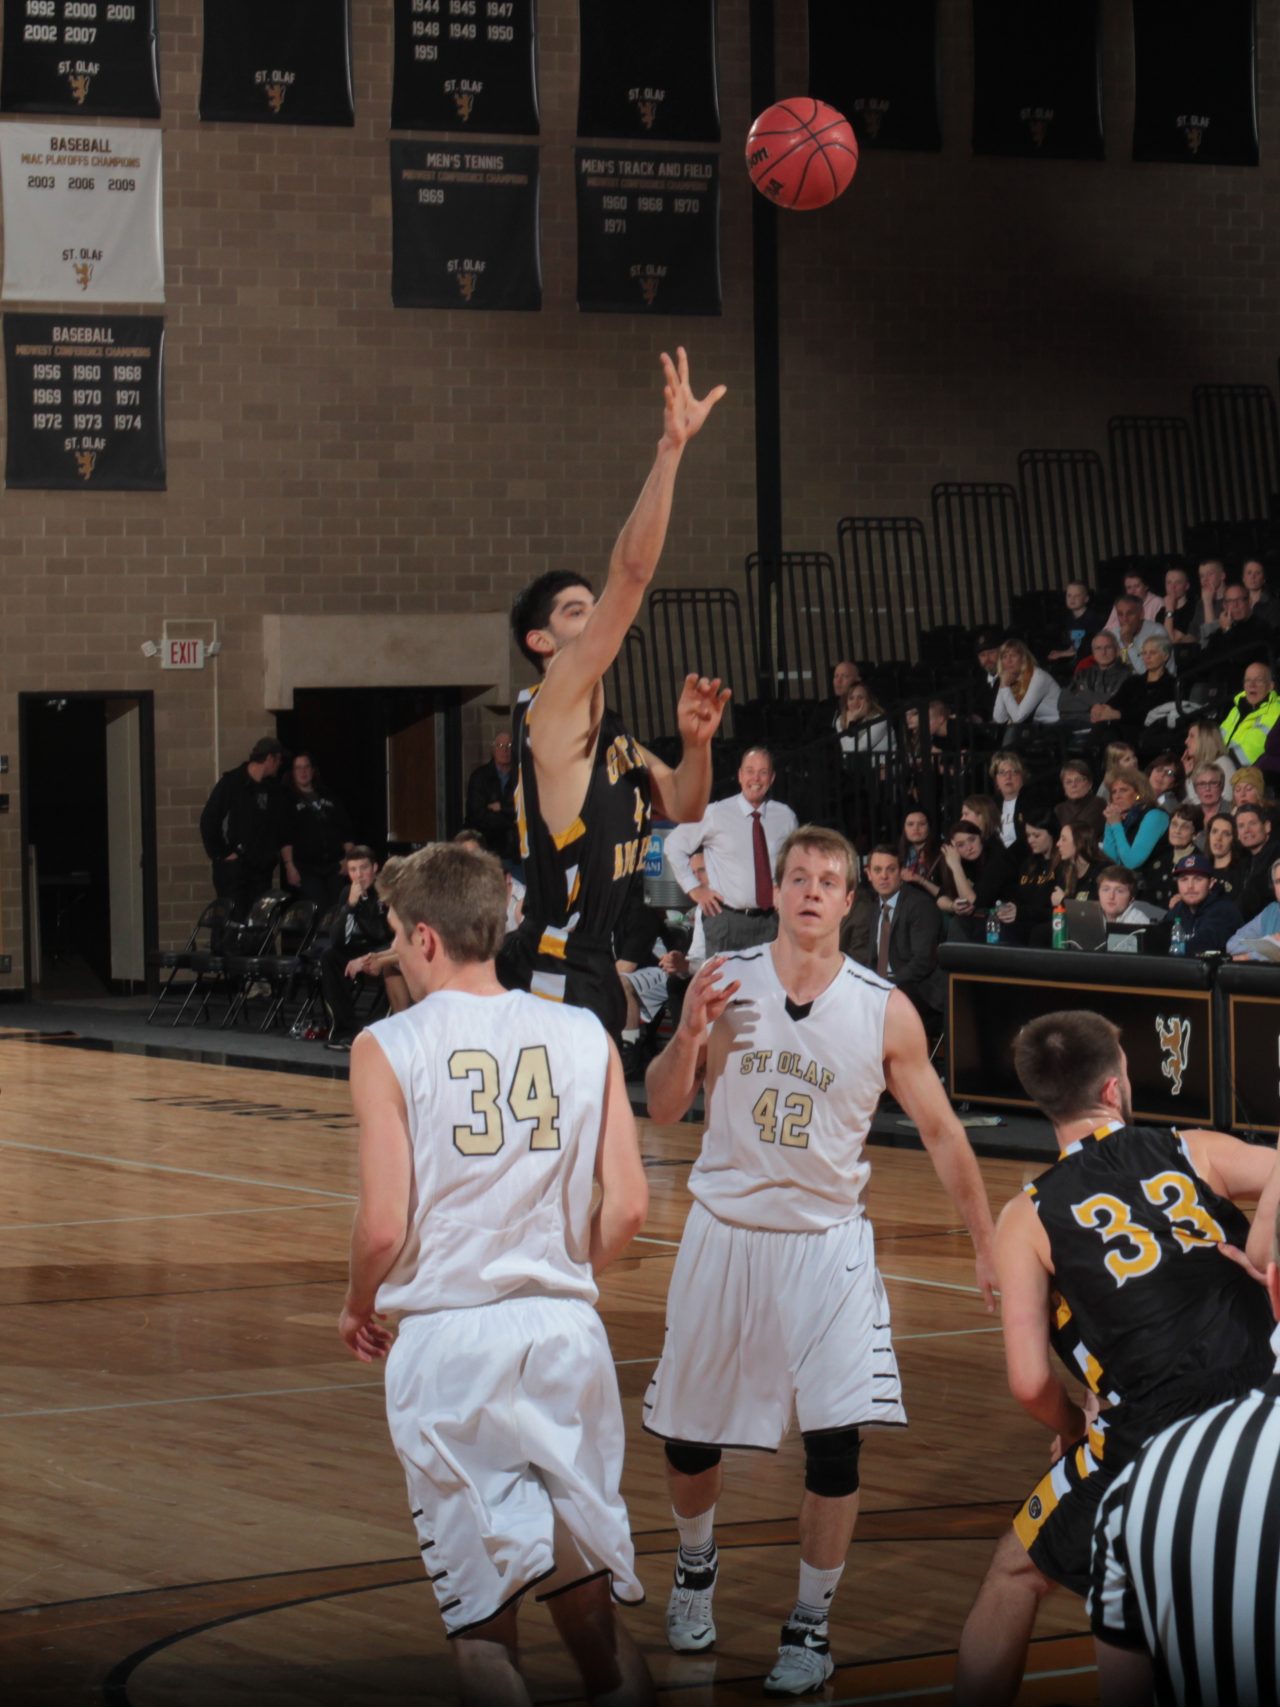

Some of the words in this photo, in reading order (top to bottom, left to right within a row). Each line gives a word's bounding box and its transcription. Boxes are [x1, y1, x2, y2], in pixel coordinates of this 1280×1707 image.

[26, 0, 55, 16] 1992
[64, 2, 97, 18] 2000
[107, 4, 136, 20] 2001
[412, 0, 440, 13] 1944
[449, 0, 477, 15] 1945
[486, 2, 514, 17] 1947
[24, 24, 57, 41] 2002
[64, 27, 97, 43] 2007
[412, 21, 440, 37] 1948
[449, 23, 477, 39] 1949
[487, 25, 514, 41] 1950
[414, 44, 438, 60] 1951
[58, 61, 73, 75] ST.
[75, 60, 100, 75] OLAF
[255, 70, 270, 83] ST.
[272, 70, 296, 84] OLAF
[444, 80, 459, 94] ST.
[460, 80, 484, 94] OLAF
[644, 88, 666, 101] OLAF
[50, 137, 112, 153] BASEBALL
[21, 153, 43, 166] MIAC
[46, 154, 89, 167] PLAYOFFS
[426, 153, 461, 169] MEN'S
[464, 154, 504, 170] TENNIS
[581, 158, 615, 174] MEN'S
[618, 160, 655, 176] TRACK
[658, 162, 681, 178] AND
[683, 163, 712, 178] FIELD
[28, 175, 55, 188] 2003
[68, 177, 95, 190] 2006
[108, 178, 136, 191] 2009
[418, 188, 445, 204] 1969
[673, 198, 700, 213] 1970
[604, 218, 626, 233] 1971
[62, 249, 77, 261] ST.
[80, 248, 103, 261] OLAF
[447, 259, 462, 272] ST.
[463, 259, 486, 272] OLAF
[52, 326, 114, 343] BASEBALL
[33, 364, 61, 380] 1956
[73, 364, 101, 381] 1960
[113, 365, 142, 381] 1968
[33, 389, 61, 405] 1969
[73, 389, 102, 406] 1970
[116, 390, 140, 406] 1971
[33, 413, 62, 429] 1972
[73, 414, 102, 430] 1973
[114, 414, 142, 430] 1974
[64, 437, 80, 450] ST.
[82, 436, 106, 450] OLAF
[171, 641, 198, 664] EXIT
[740, 1050, 773, 1075] ST.
[777, 1051, 835, 1093] OLAF
[448, 1045, 561, 1156] 34
[752, 1087, 813, 1149] 42
[1070, 1170, 1227, 1290] 33
